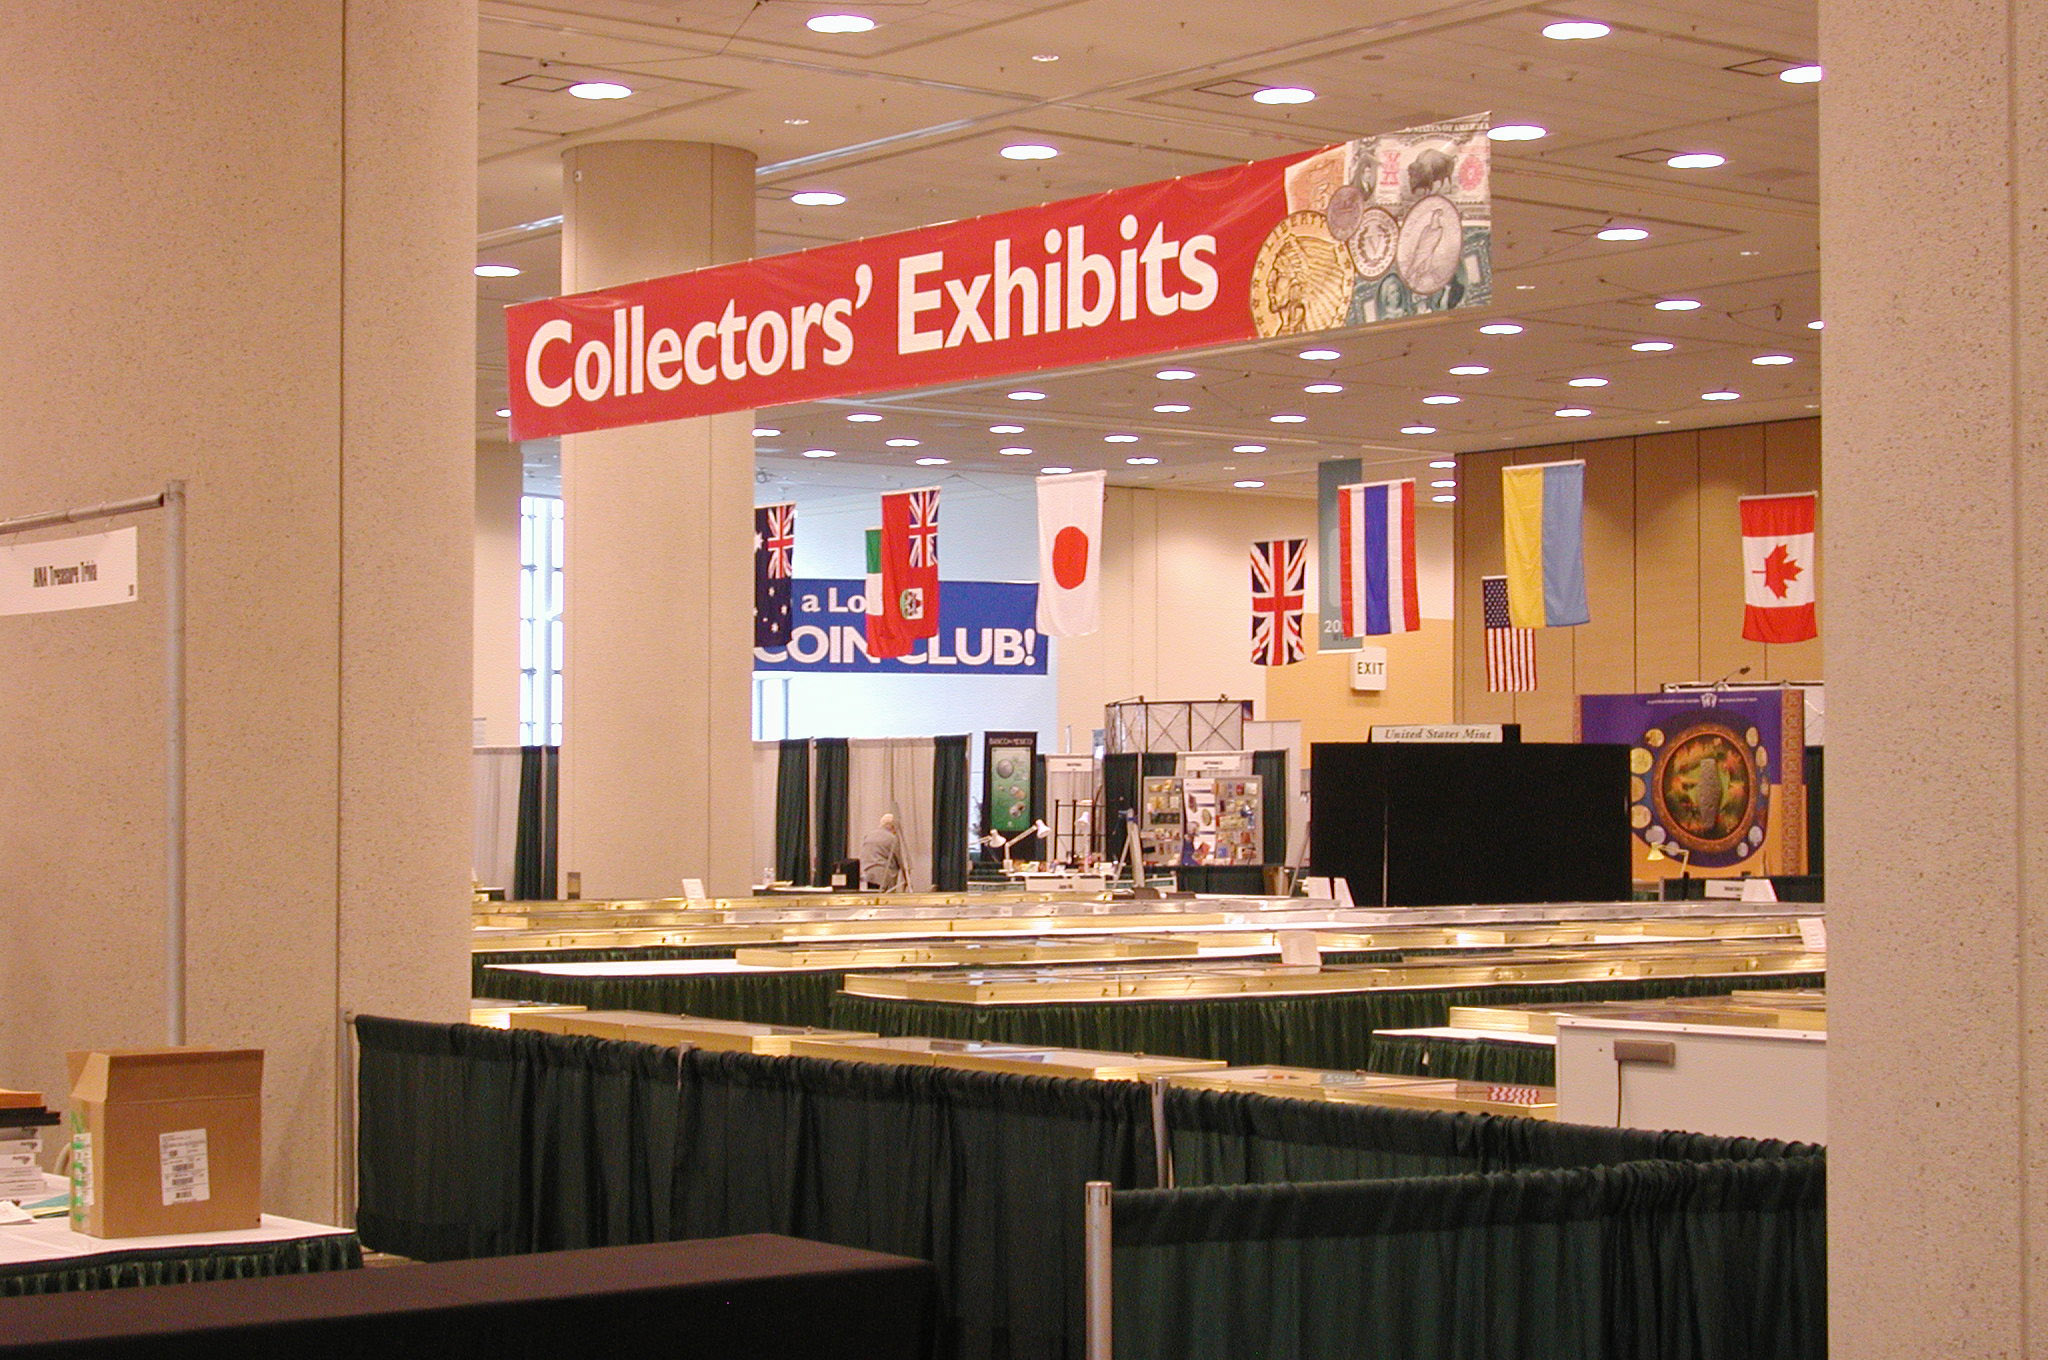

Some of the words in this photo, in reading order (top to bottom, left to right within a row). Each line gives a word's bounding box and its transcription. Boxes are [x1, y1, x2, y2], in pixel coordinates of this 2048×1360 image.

[525, 264, 873, 407] Collectors'
[898, 214, 1219, 355] Exhibits
[801, 594, 821, 613] a
[828, 587, 866, 613] Lo
[896, 627, 1036, 667] LUB!
[1357, 661, 1384, 675] EXIT
[1385, 727, 1422, 739] United
[1426, 727, 1458, 739] States
[1462, 727, 1492, 739] Mint
